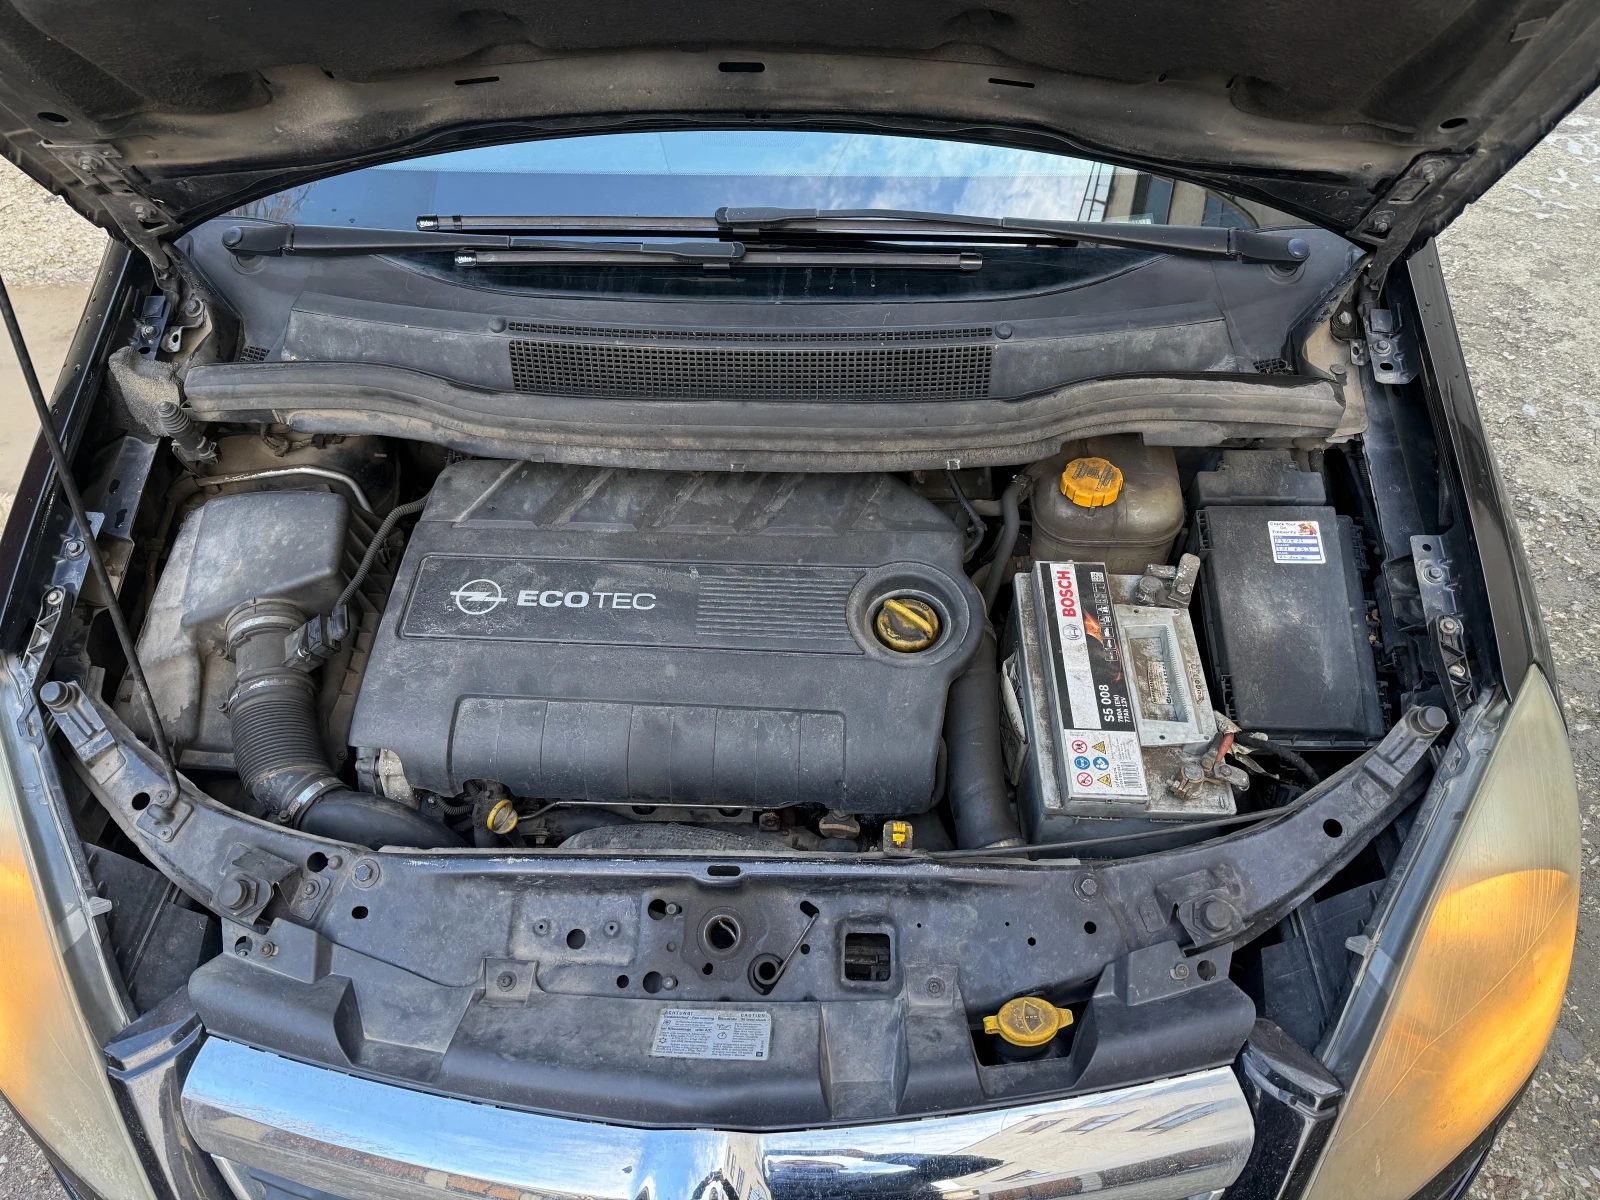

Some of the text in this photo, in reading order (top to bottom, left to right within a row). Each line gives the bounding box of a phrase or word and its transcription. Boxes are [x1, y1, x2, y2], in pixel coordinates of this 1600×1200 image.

[517, 590, 657, 610] ECOTEC
[1056, 571, 1077, 617] BOSCH
[1099, 684, 1115, 722] S5 008
[1120, 696, 1128, 708] 12V
